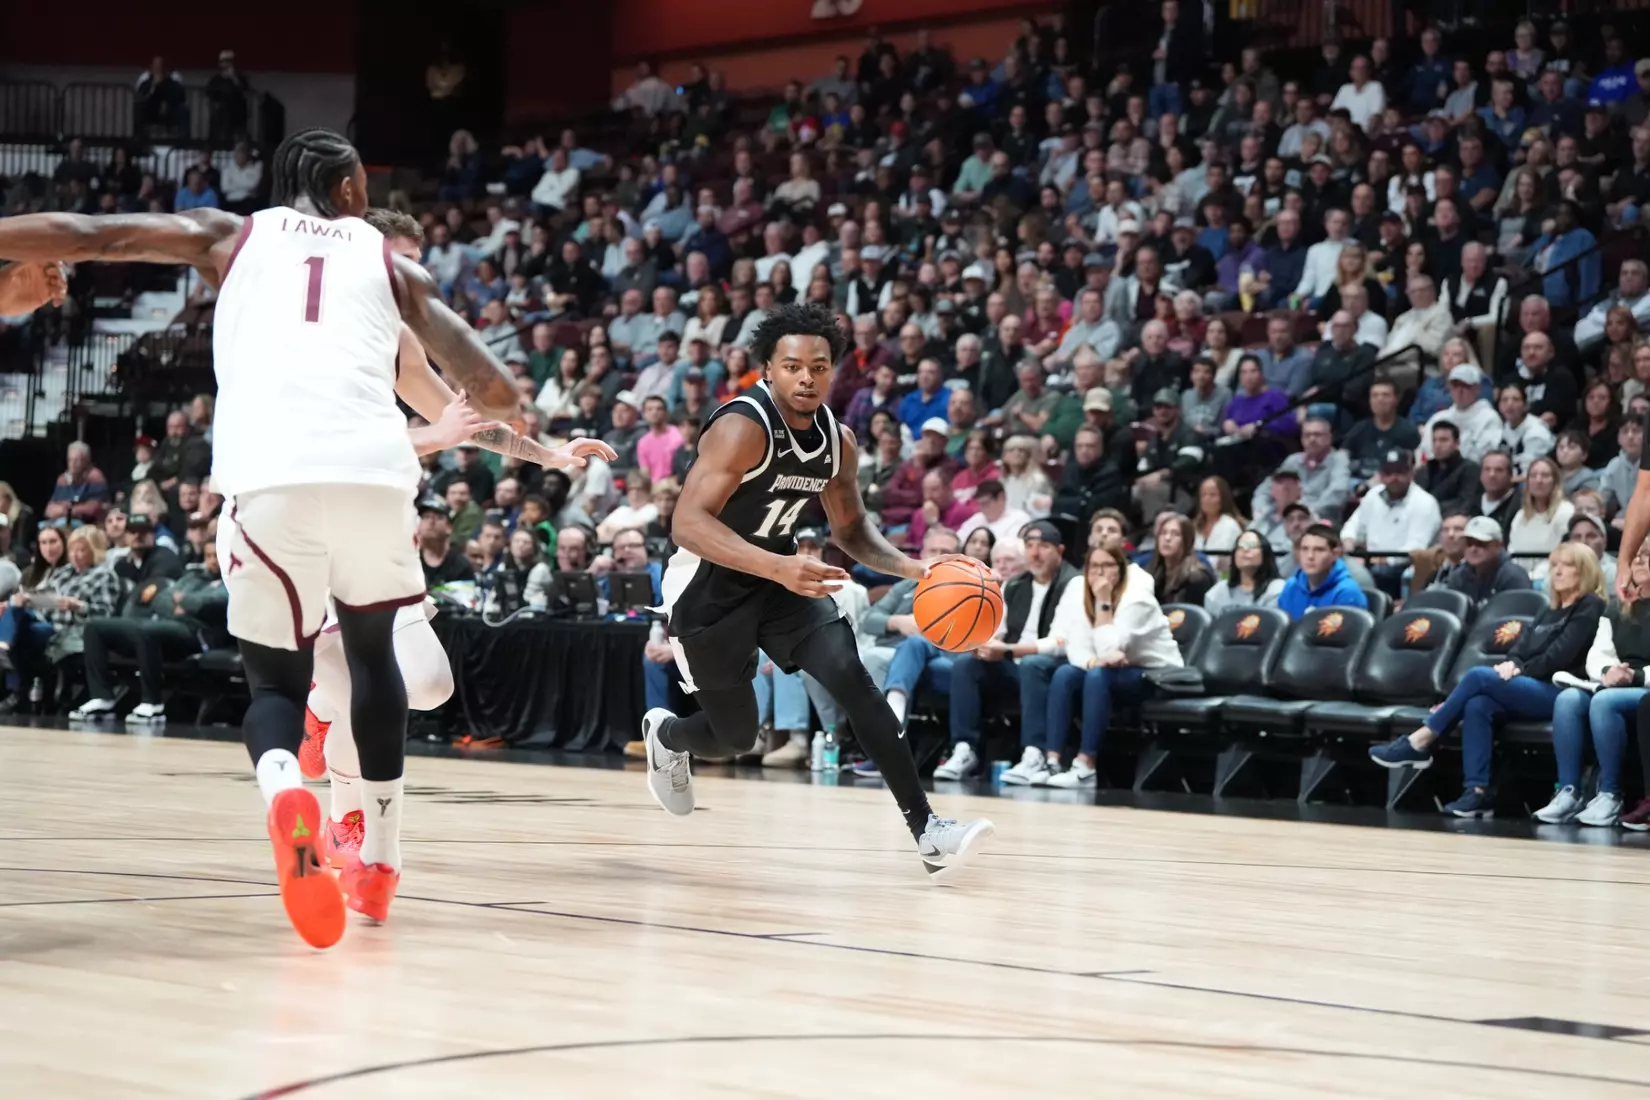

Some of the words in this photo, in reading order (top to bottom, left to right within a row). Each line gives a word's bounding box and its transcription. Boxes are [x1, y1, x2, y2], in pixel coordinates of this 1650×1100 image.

[303, 256, 325, 323] 1
[767, 474, 829, 493] PROVIDENCE
[752, 498, 810, 538] 14
